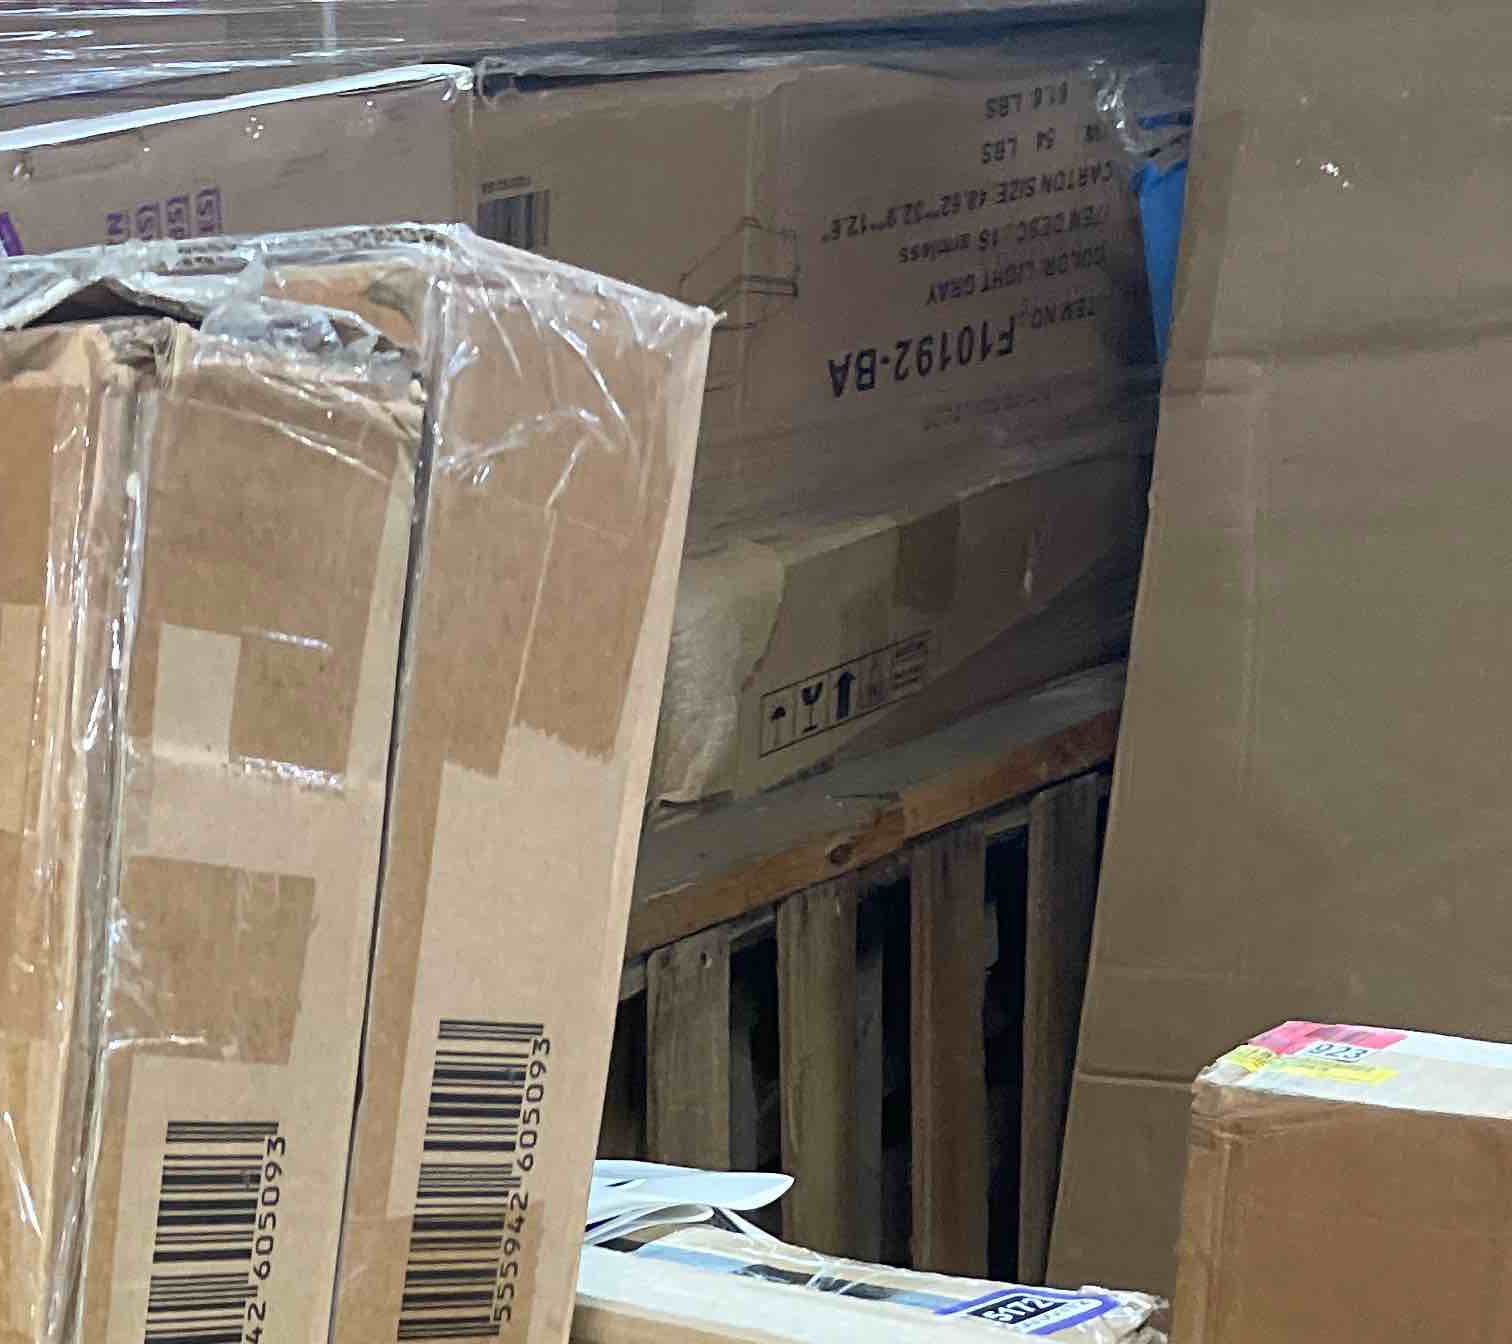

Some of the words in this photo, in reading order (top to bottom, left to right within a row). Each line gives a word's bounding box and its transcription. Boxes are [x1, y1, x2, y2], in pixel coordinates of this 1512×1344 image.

[825, 314, 1019, 399] F10192-BA
[254, 1136, 287, 1281] 605093
[495, 1190, 529, 1322] 555942
[517, 1037, 552, 1172] 605093
